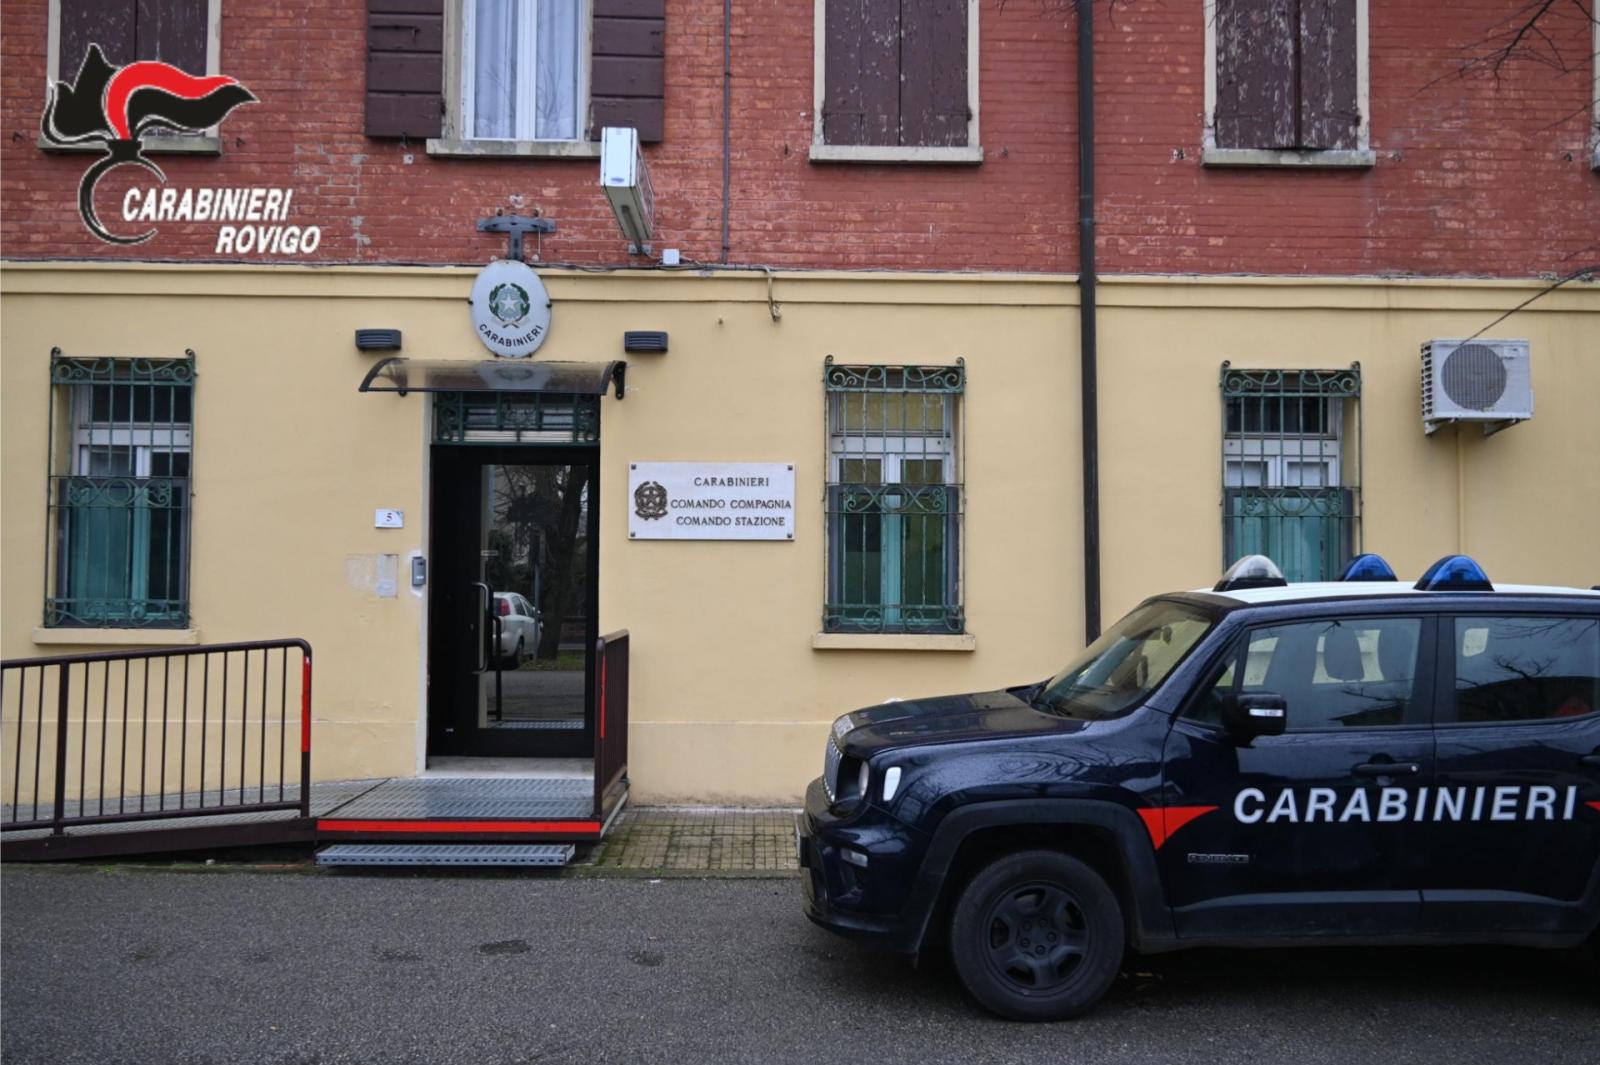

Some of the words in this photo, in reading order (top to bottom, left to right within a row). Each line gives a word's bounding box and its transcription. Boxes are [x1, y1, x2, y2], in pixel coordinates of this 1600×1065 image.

[479, 322, 544, 348] CARABINIERI
[694, 477, 770, 487] CARABINIERI
[670, 499, 725, 509] COMANDO
[730, 499, 792, 510] COMPAGNIA
[386, 512, 393, 522] 5
[676, 516, 731, 526] COMANDO
[735, 516, 785, 526] STAZIONE
[1233, 785, 1577, 824] CARABINIERI
